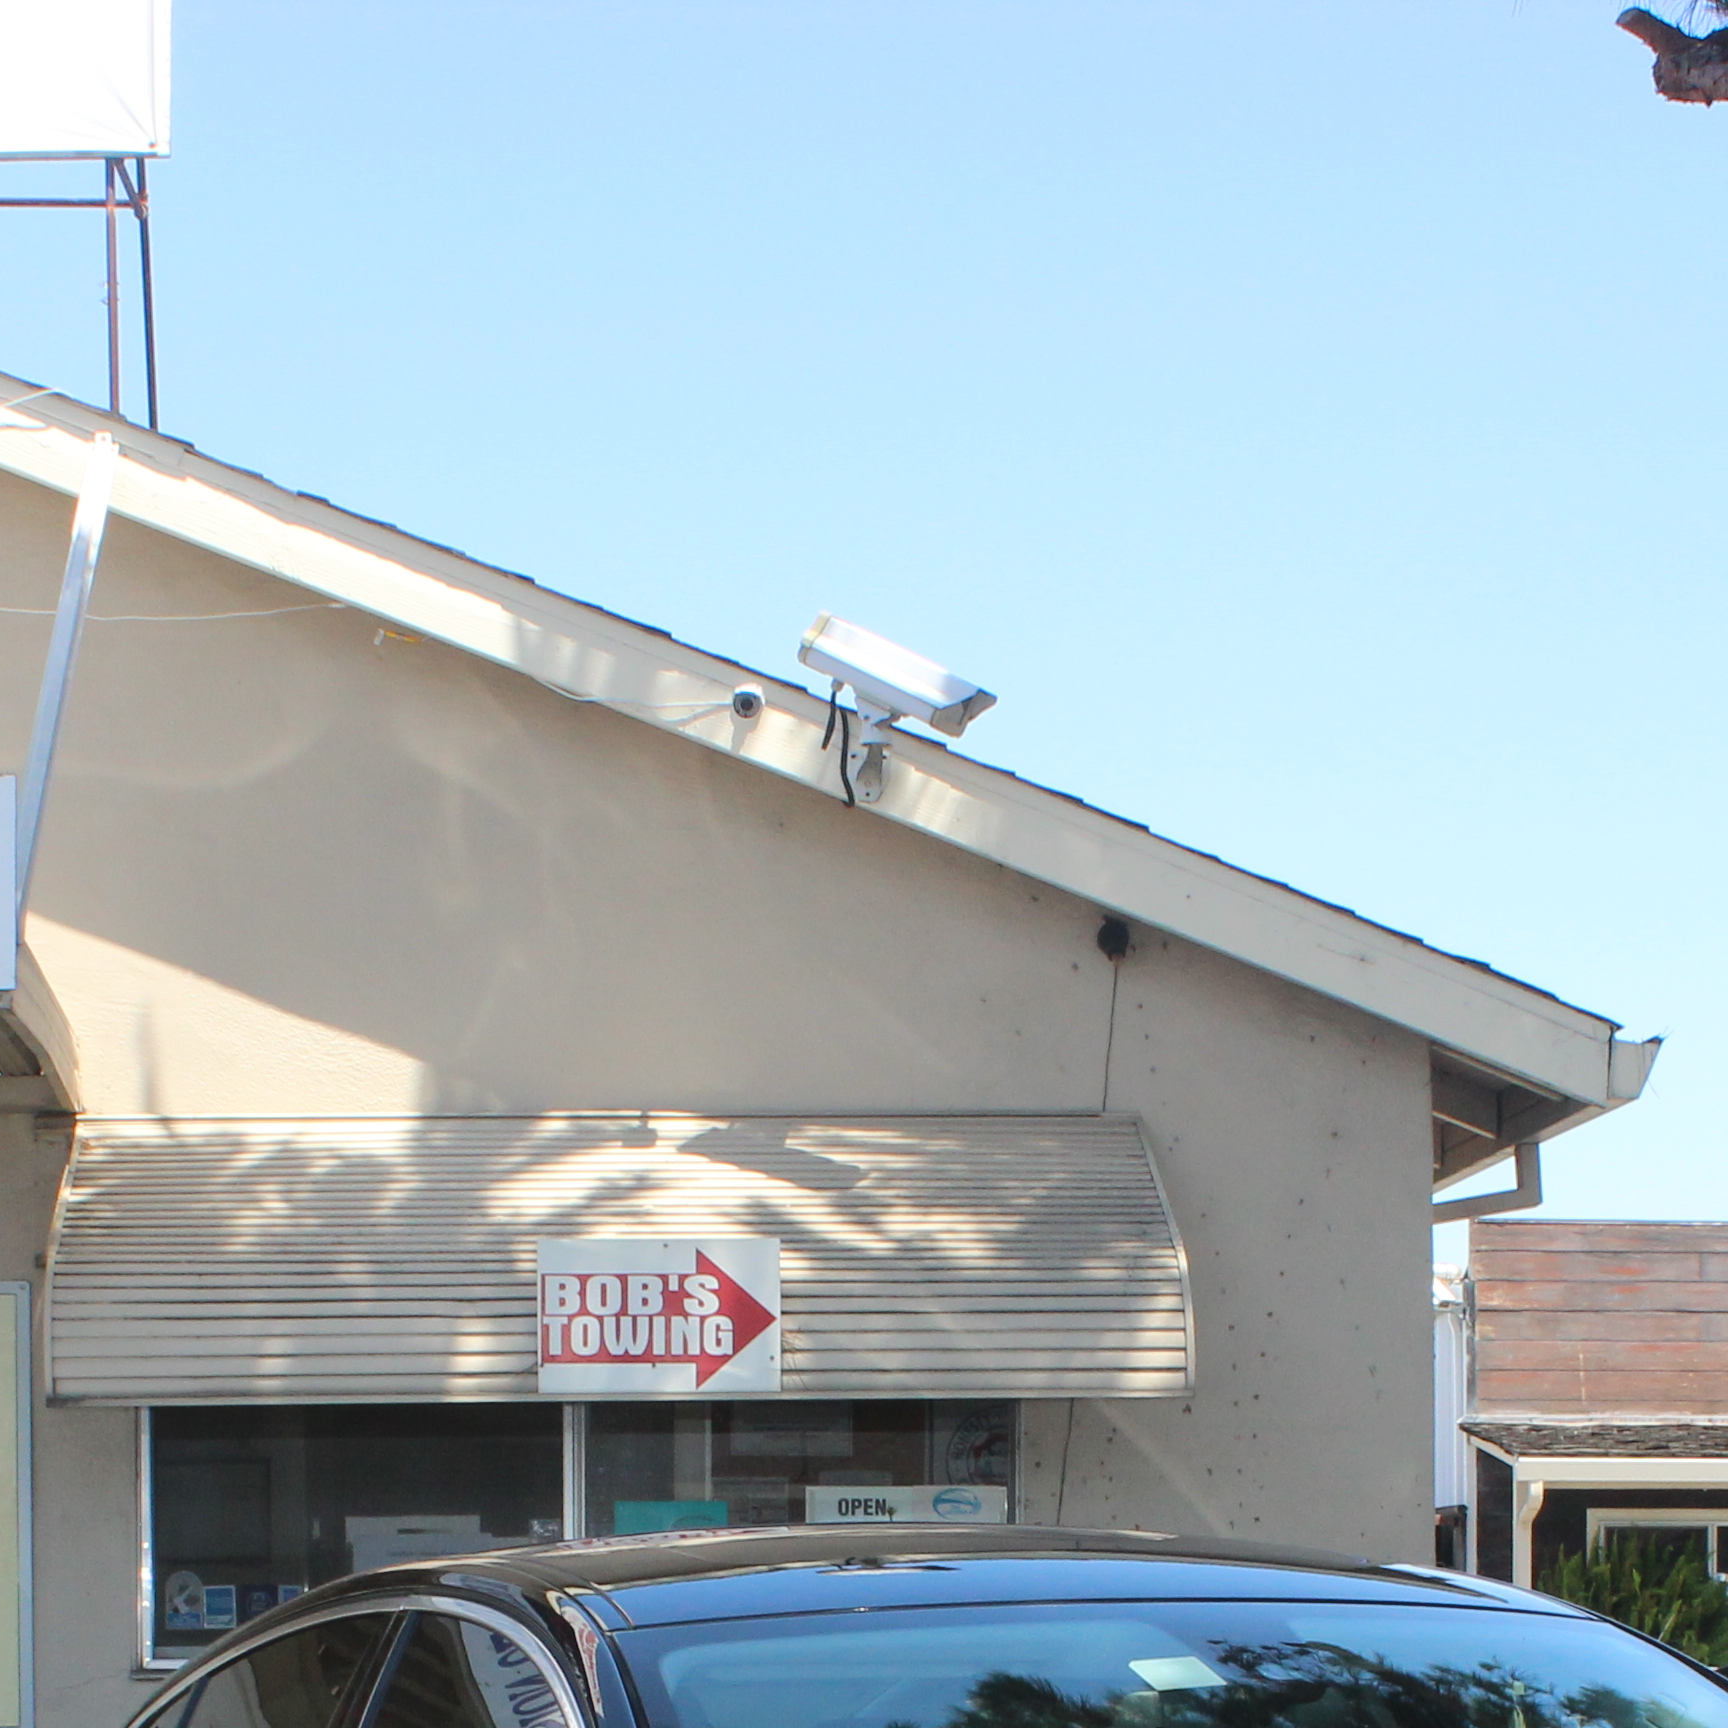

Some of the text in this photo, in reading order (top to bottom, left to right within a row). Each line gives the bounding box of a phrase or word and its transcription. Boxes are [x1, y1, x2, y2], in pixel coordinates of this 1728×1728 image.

[544, 1274, 720, 1316] BOB'S
[543, 1315, 734, 1356] TOWING
[838, 1498, 887, 1516] OPEN
